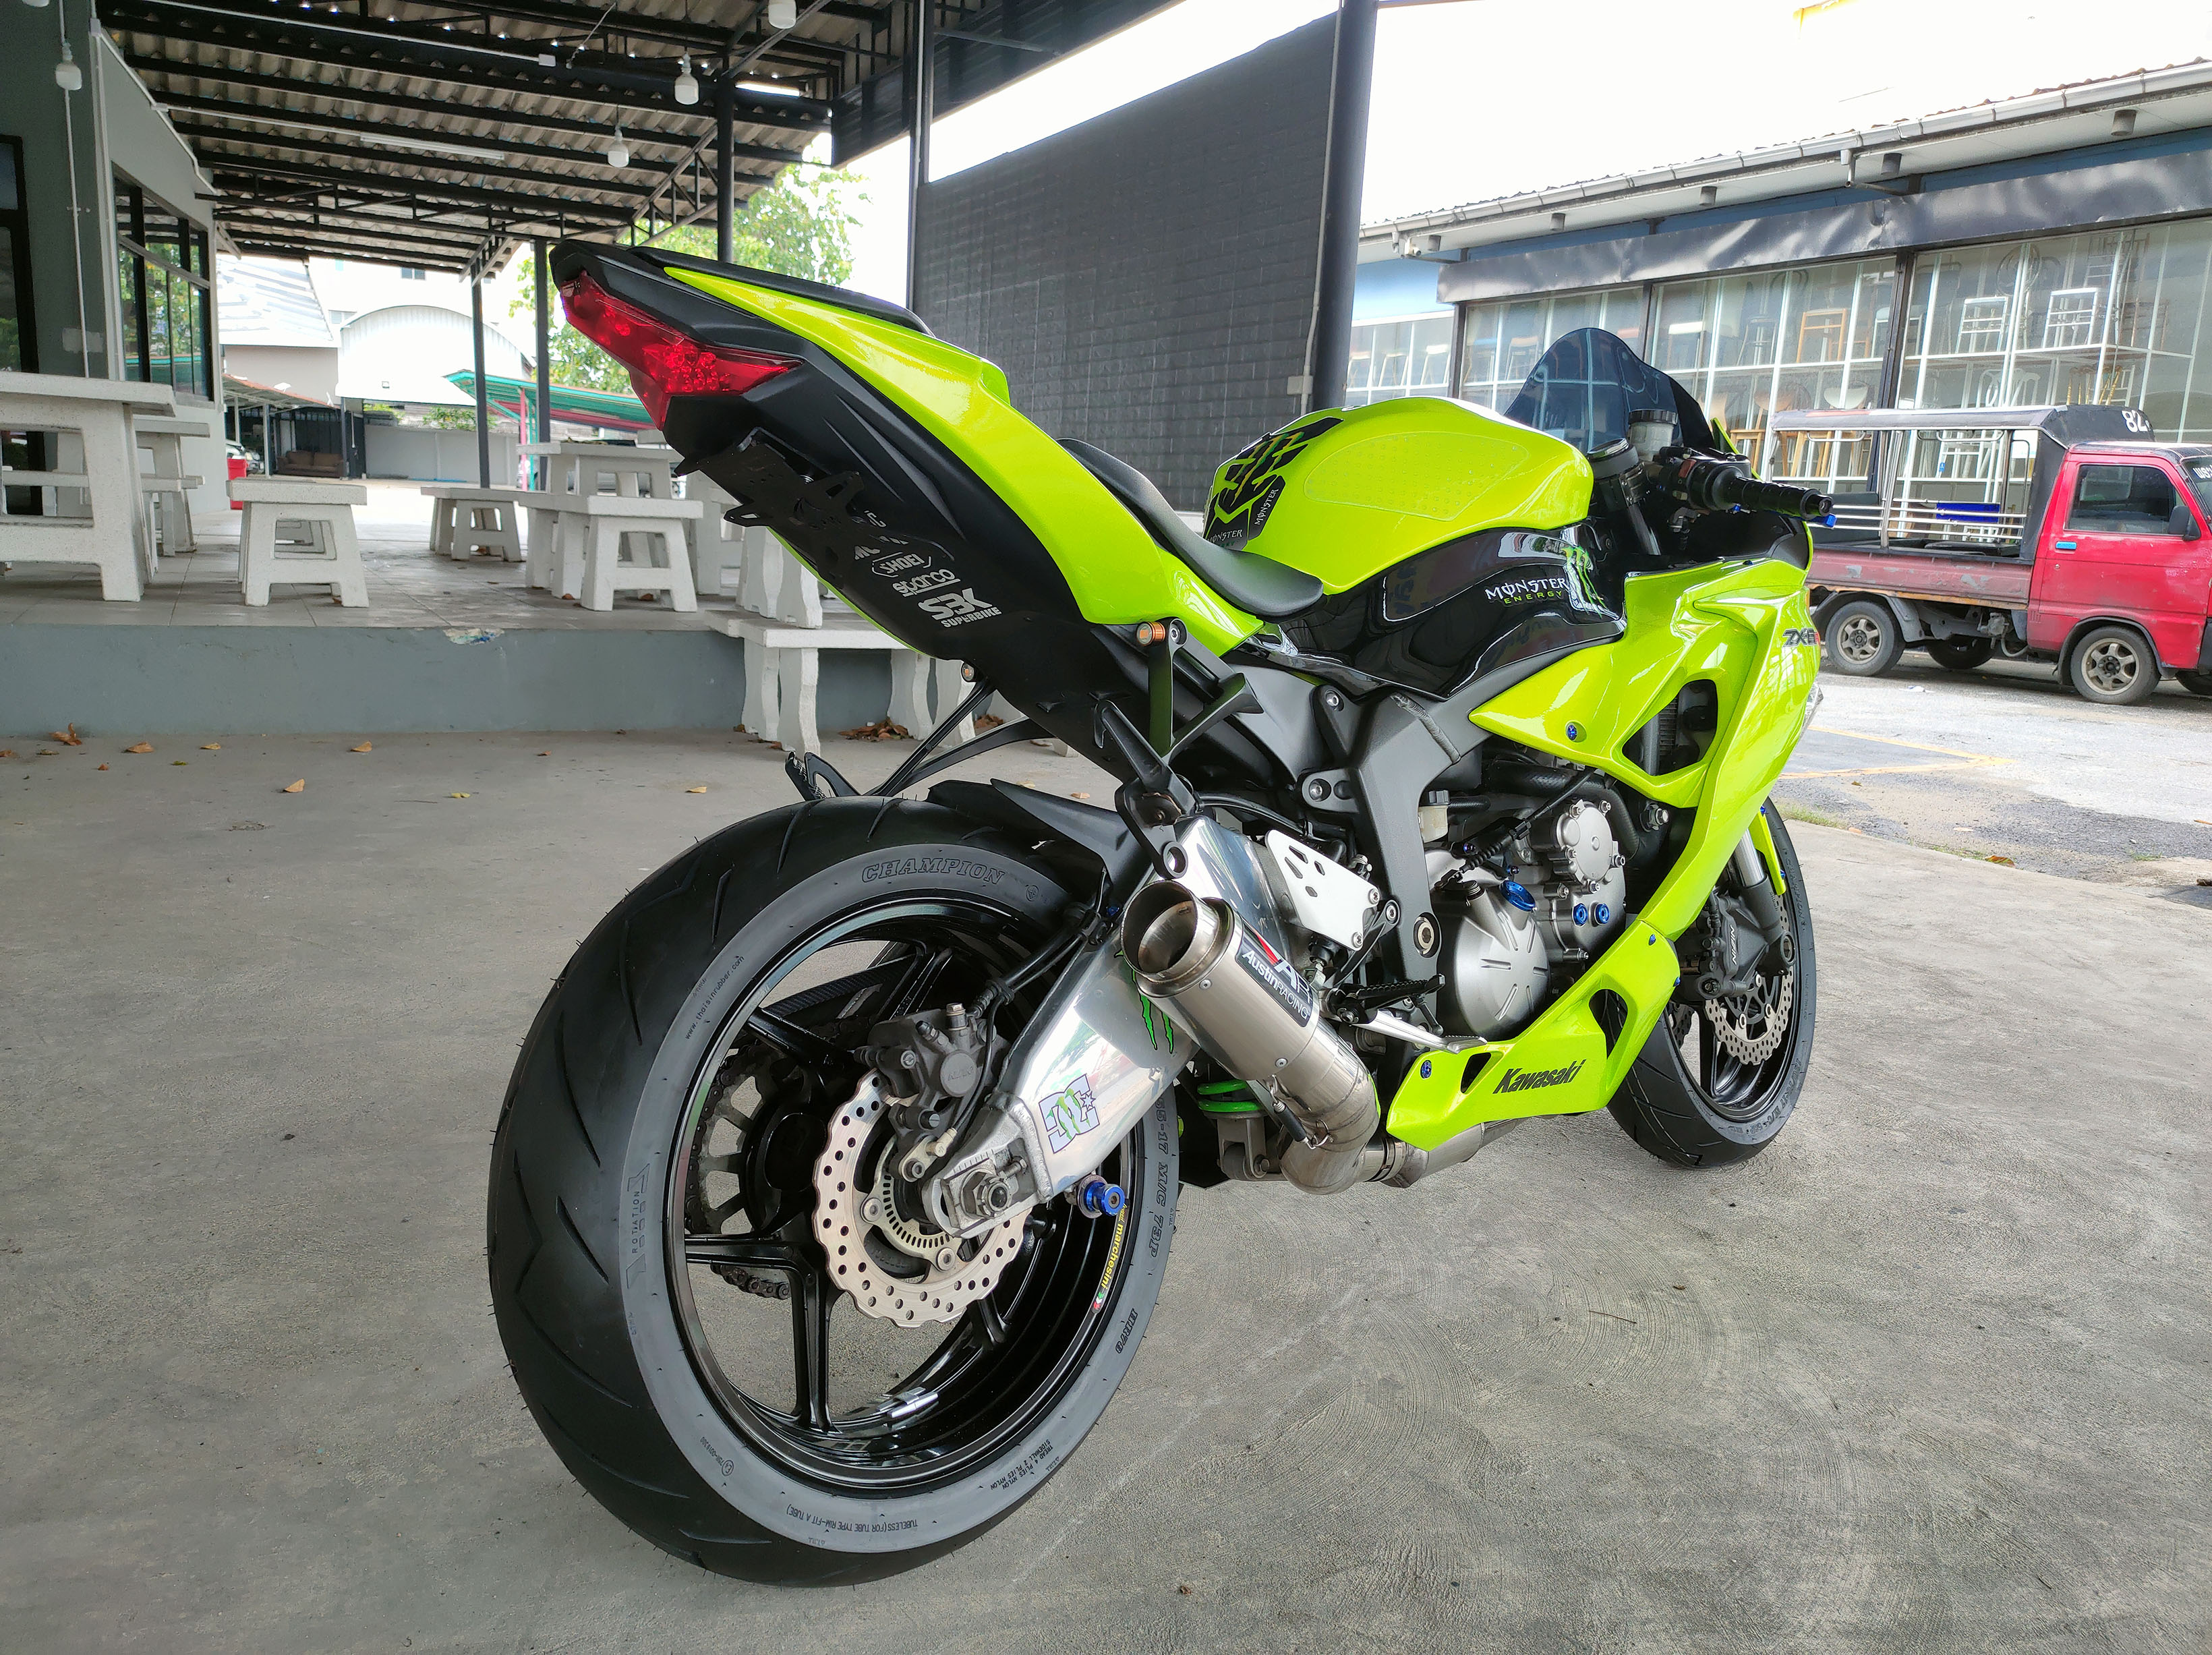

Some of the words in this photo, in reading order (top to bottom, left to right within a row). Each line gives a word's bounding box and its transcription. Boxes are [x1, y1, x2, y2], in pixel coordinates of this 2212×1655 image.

[1254, 488, 1279, 525] MONSTER
[879, 554, 925, 574] SHOEI
[892, 569, 956, 596] sparco
[1485, 577, 1570, 600] MONSTER
[1504, 591, 1563, 604] ENERGY
[941, 606, 1002, 628] SUPERBIKE
[861, 857, 1006, 885] CHAMPION
[1492, 1059, 1587, 1095] Kawasaki
[1156, 1161, 1169, 1207] M/C
[631, 1191, 641, 1254] ROTATION
[1148, 1214, 1165, 1258] 73P
[1101, 1223, 1124, 1290] marchesini
[1030, 1439, 1051, 1461] SIDEWALL
[1040, 1445, 1054, 1461] TREAD
[1008, 1464, 1023, 1477] PLIES
[1020, 1464, 1034, 1478] PLIES
[990, 1476, 1007, 1490] NYLON
[1002, 1476, 1018, 1490] NYLON
[837, 1521, 853, 1532] TYPE
[854, 1523, 870, 1532] TUBE
